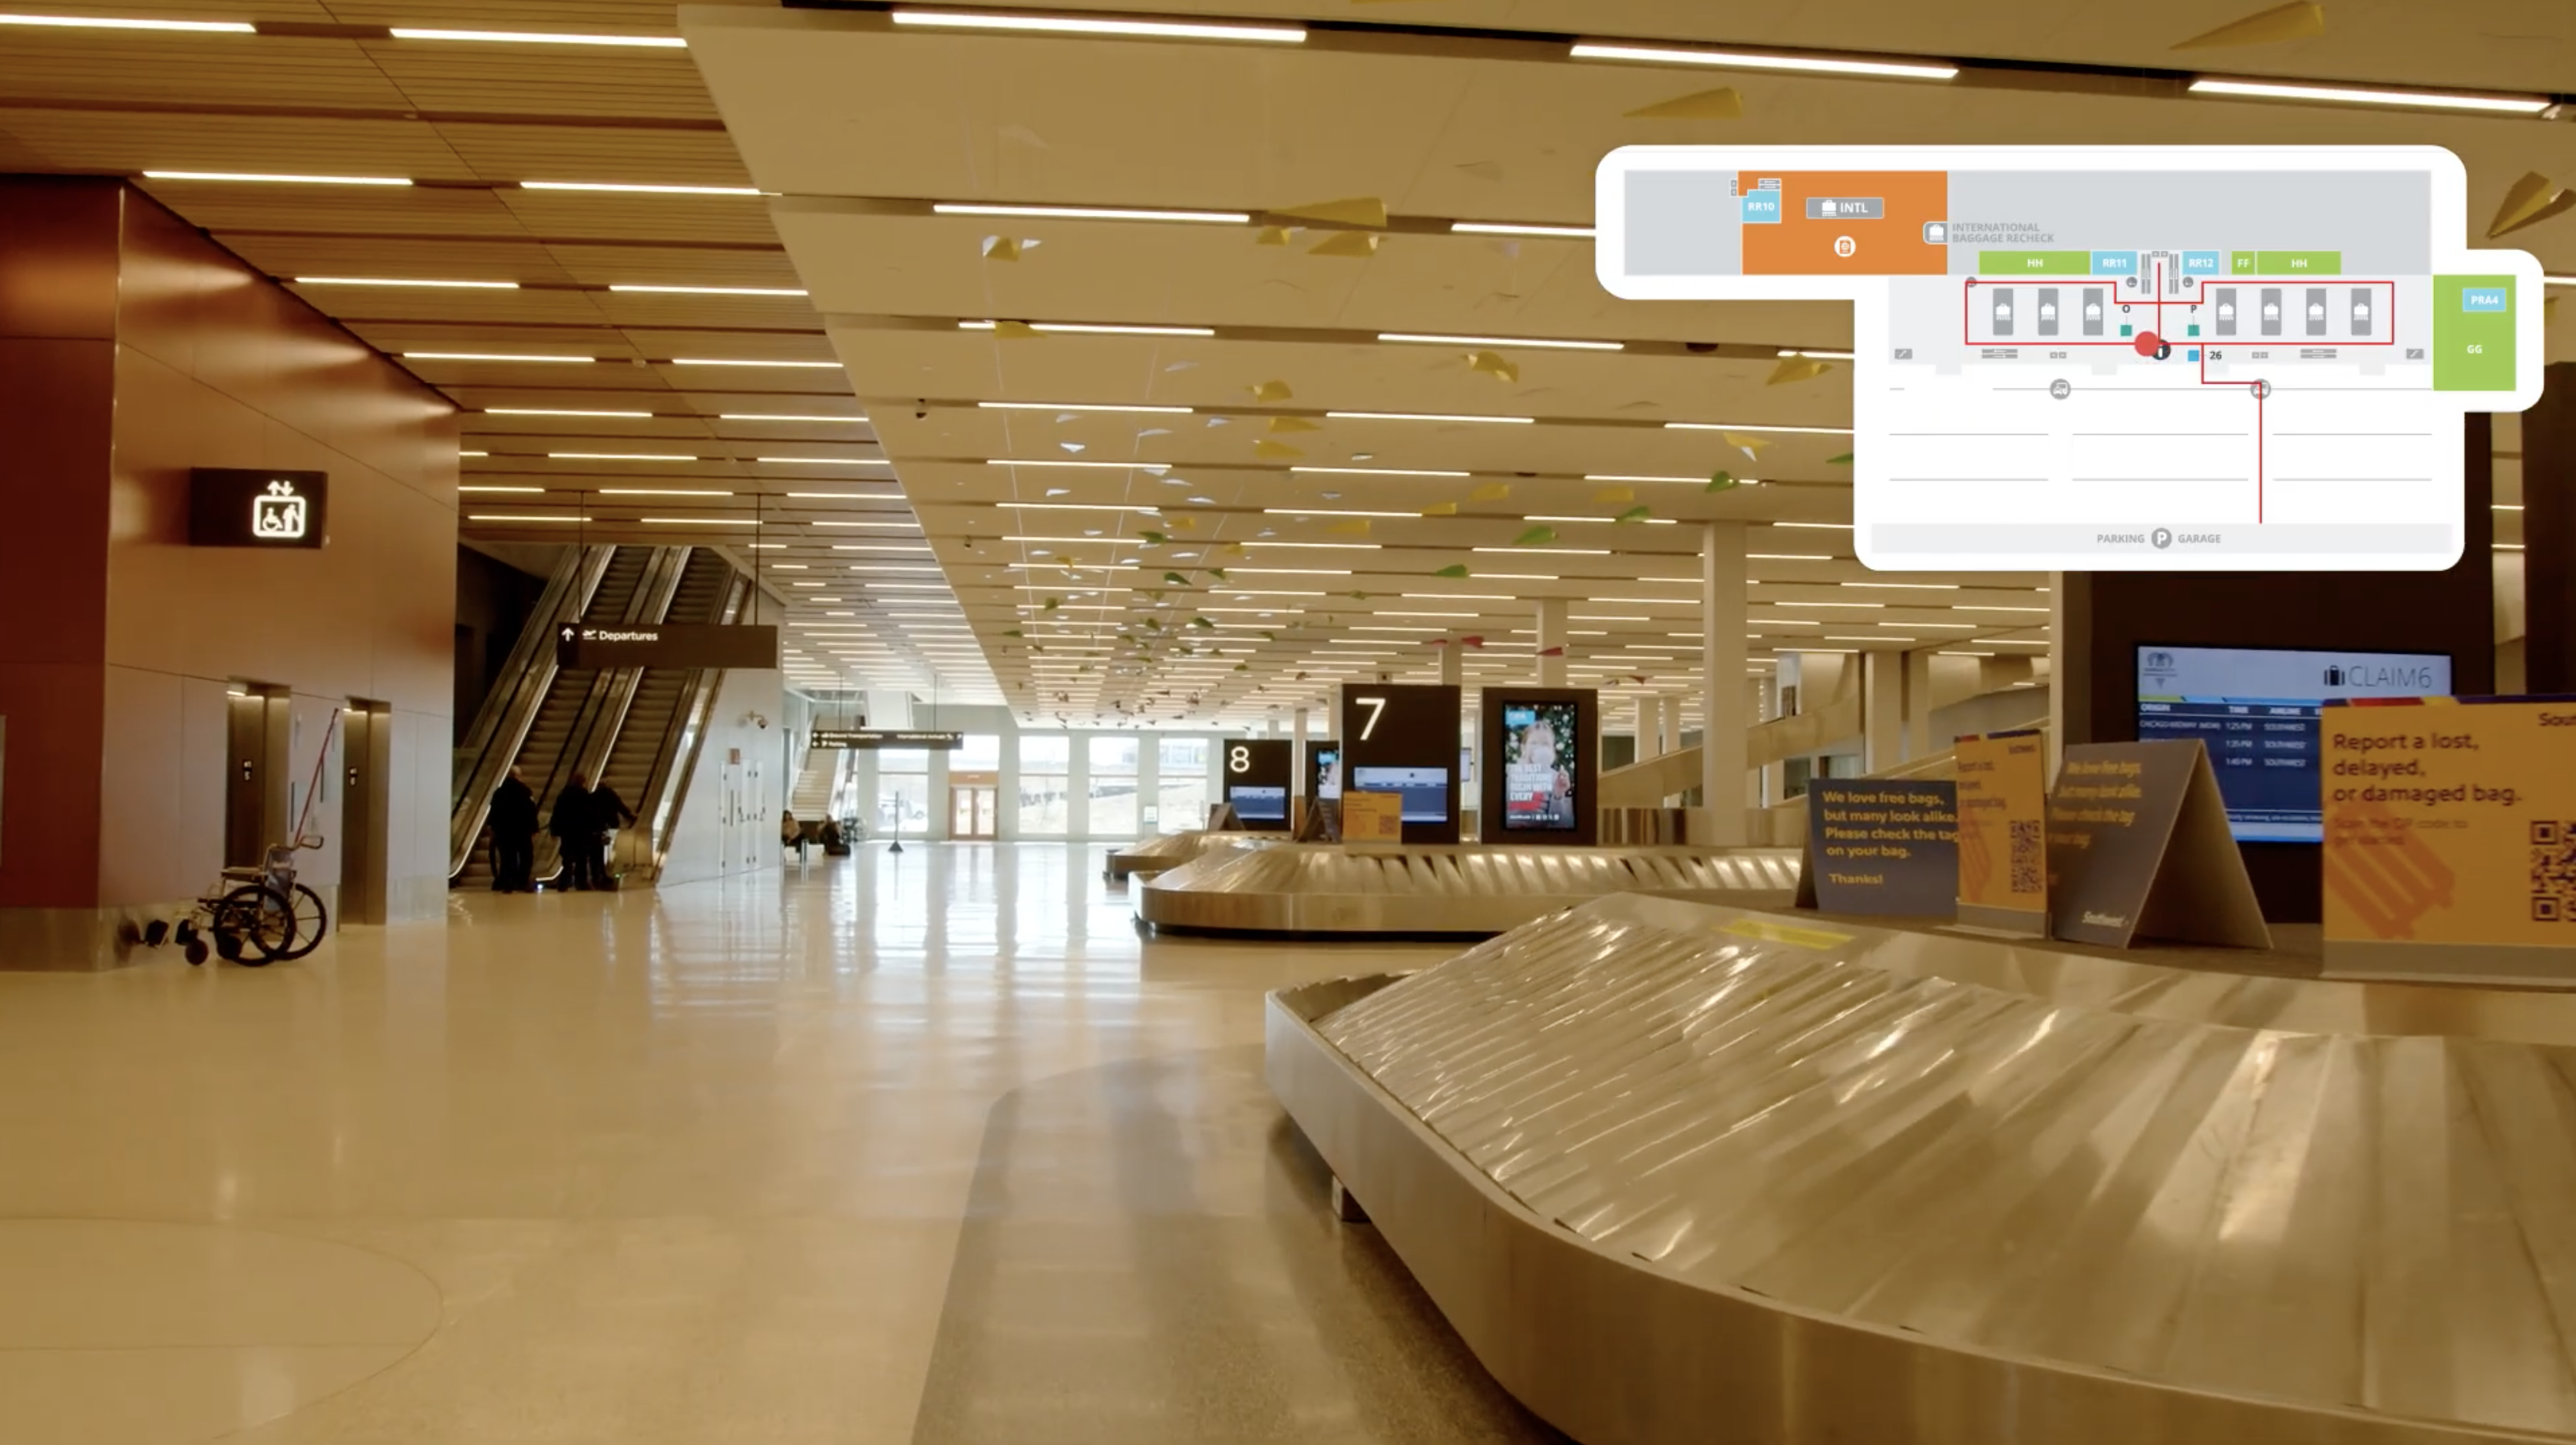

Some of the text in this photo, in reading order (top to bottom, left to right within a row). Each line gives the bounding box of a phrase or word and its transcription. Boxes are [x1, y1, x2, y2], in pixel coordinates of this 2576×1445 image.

[599, 630, 659, 642] Departures
[2140, 703, 2302, 716] ORIGIN TIME AIRLINE
[1355, 697, 1386, 741] 7
[2333, 732, 2479, 754] Report a lost,
[1230, 746, 1250, 773] 8
[2333, 759, 2426, 779] delayed,
[1822, 791, 1844, 803] We
[1848, 792, 1876, 803] love
[1880, 792, 1905, 804] free
[2333, 784, 2522, 807] or damaged bag.
[1824, 809, 1847, 822] but
[1850, 812, 1887, 824] many
[1890, 810, 1920, 822] look
[1825, 827, 1868, 839] Please
[1871, 828, 1910, 840] check
[1913, 828, 1936, 840] the
[1826, 845, 1911, 859] on your bag.
[1828, 873, 1884, 885] Thanks!
